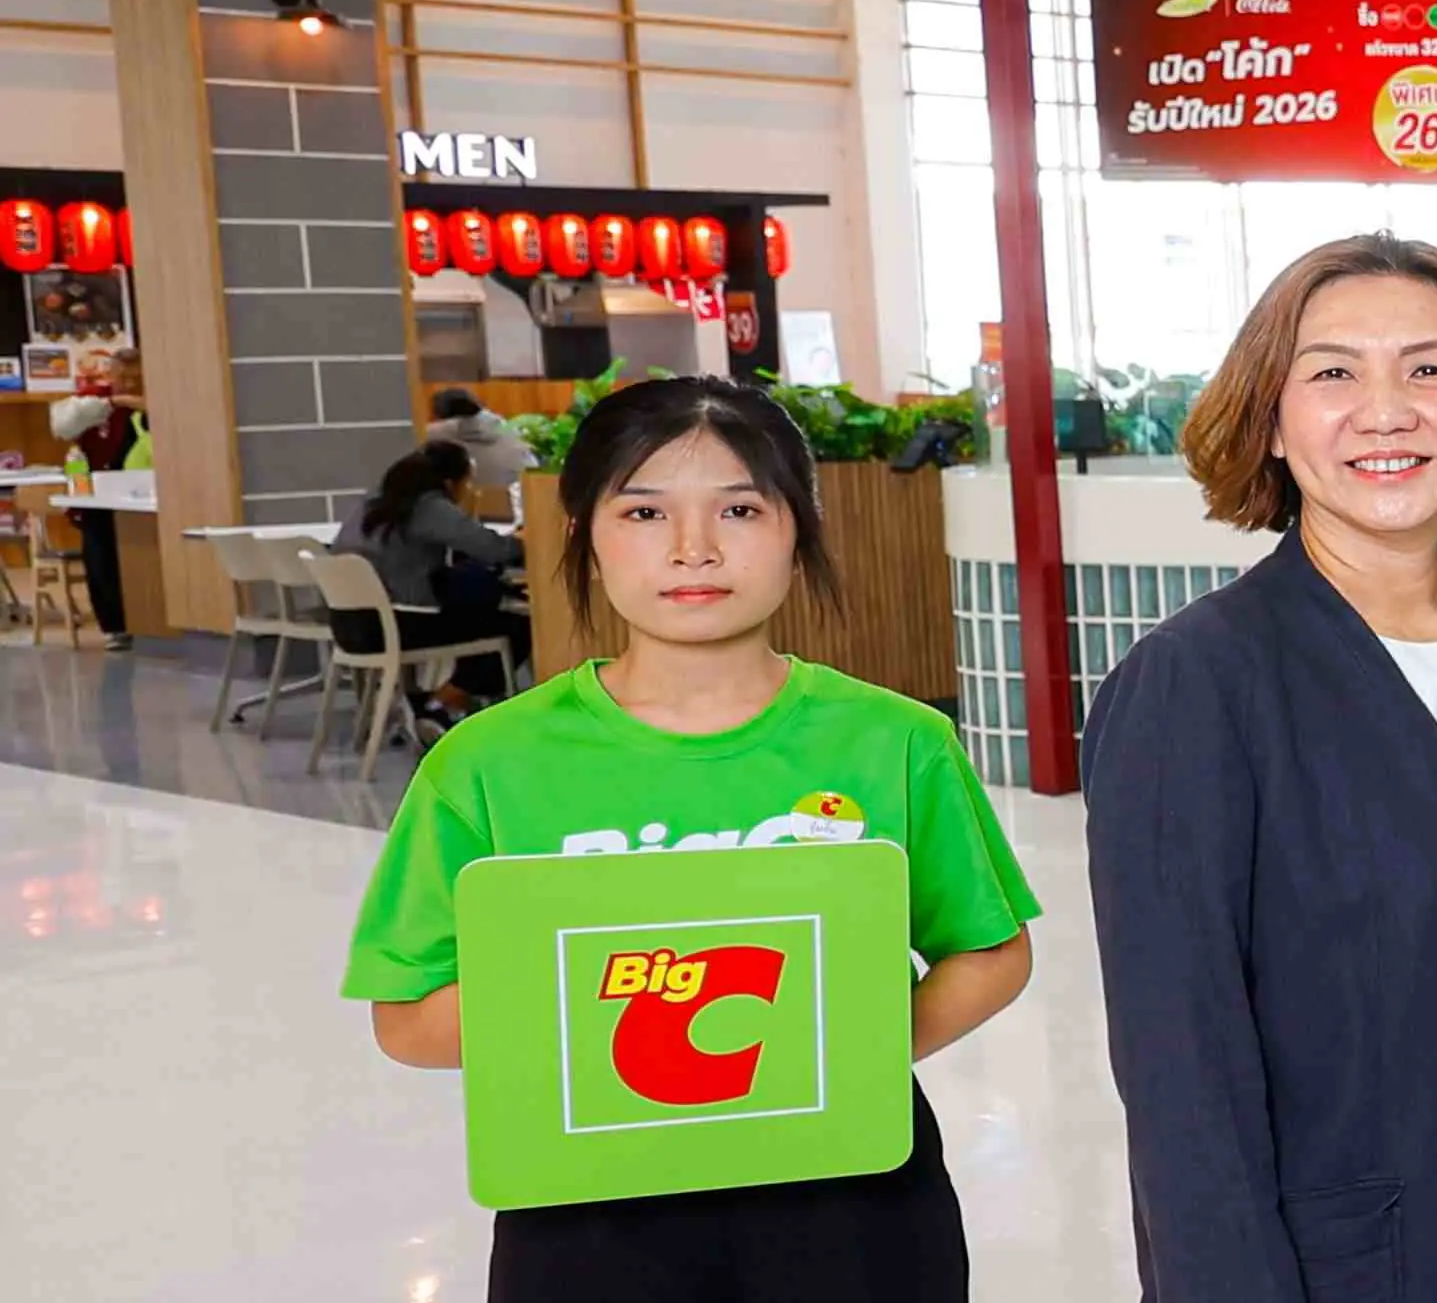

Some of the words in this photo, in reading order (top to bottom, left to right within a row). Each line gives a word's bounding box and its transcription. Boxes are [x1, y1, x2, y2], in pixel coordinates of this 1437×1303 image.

[1127, 94, 1245, 134] รับปีใหม่
[1253, 90, 1338, 125] 2026
[602, 950, 706, 1002] Big
